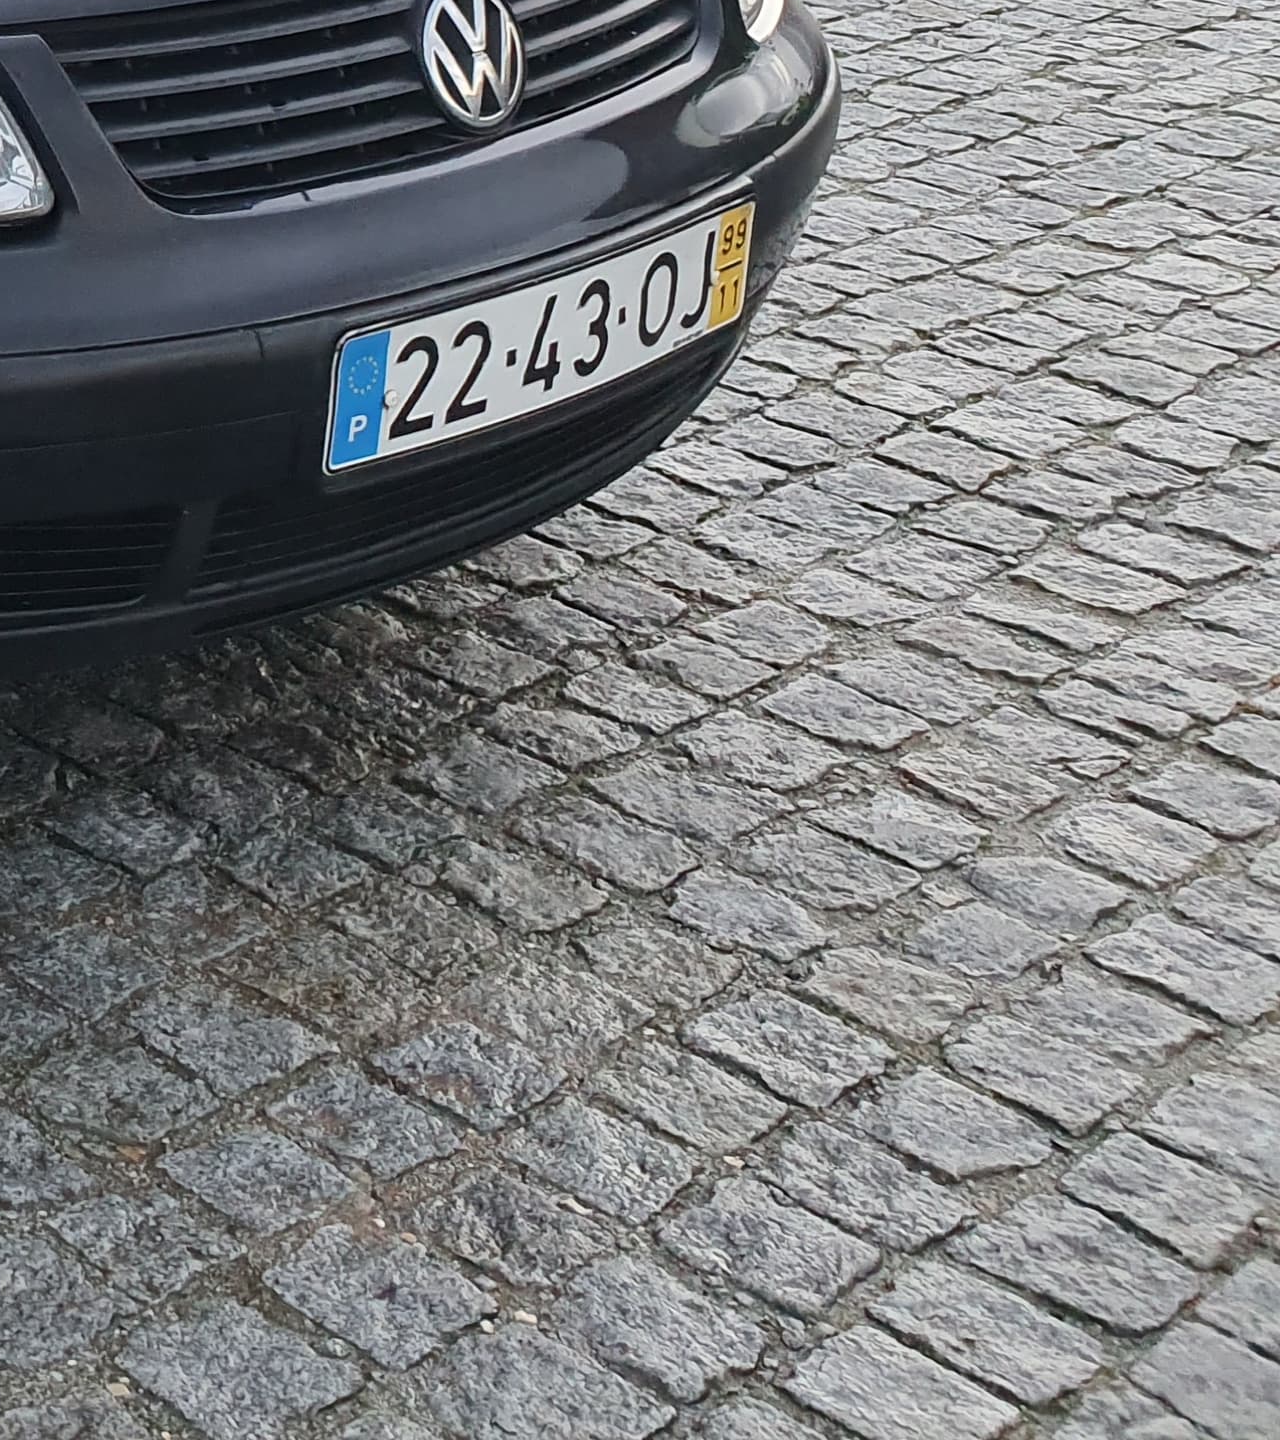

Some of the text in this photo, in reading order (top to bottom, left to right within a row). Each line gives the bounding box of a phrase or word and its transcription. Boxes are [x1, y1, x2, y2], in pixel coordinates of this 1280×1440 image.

[721, 217, 748, 256] 99
[719, 278, 740, 313] 11
[348, 414, 368, 442] P
